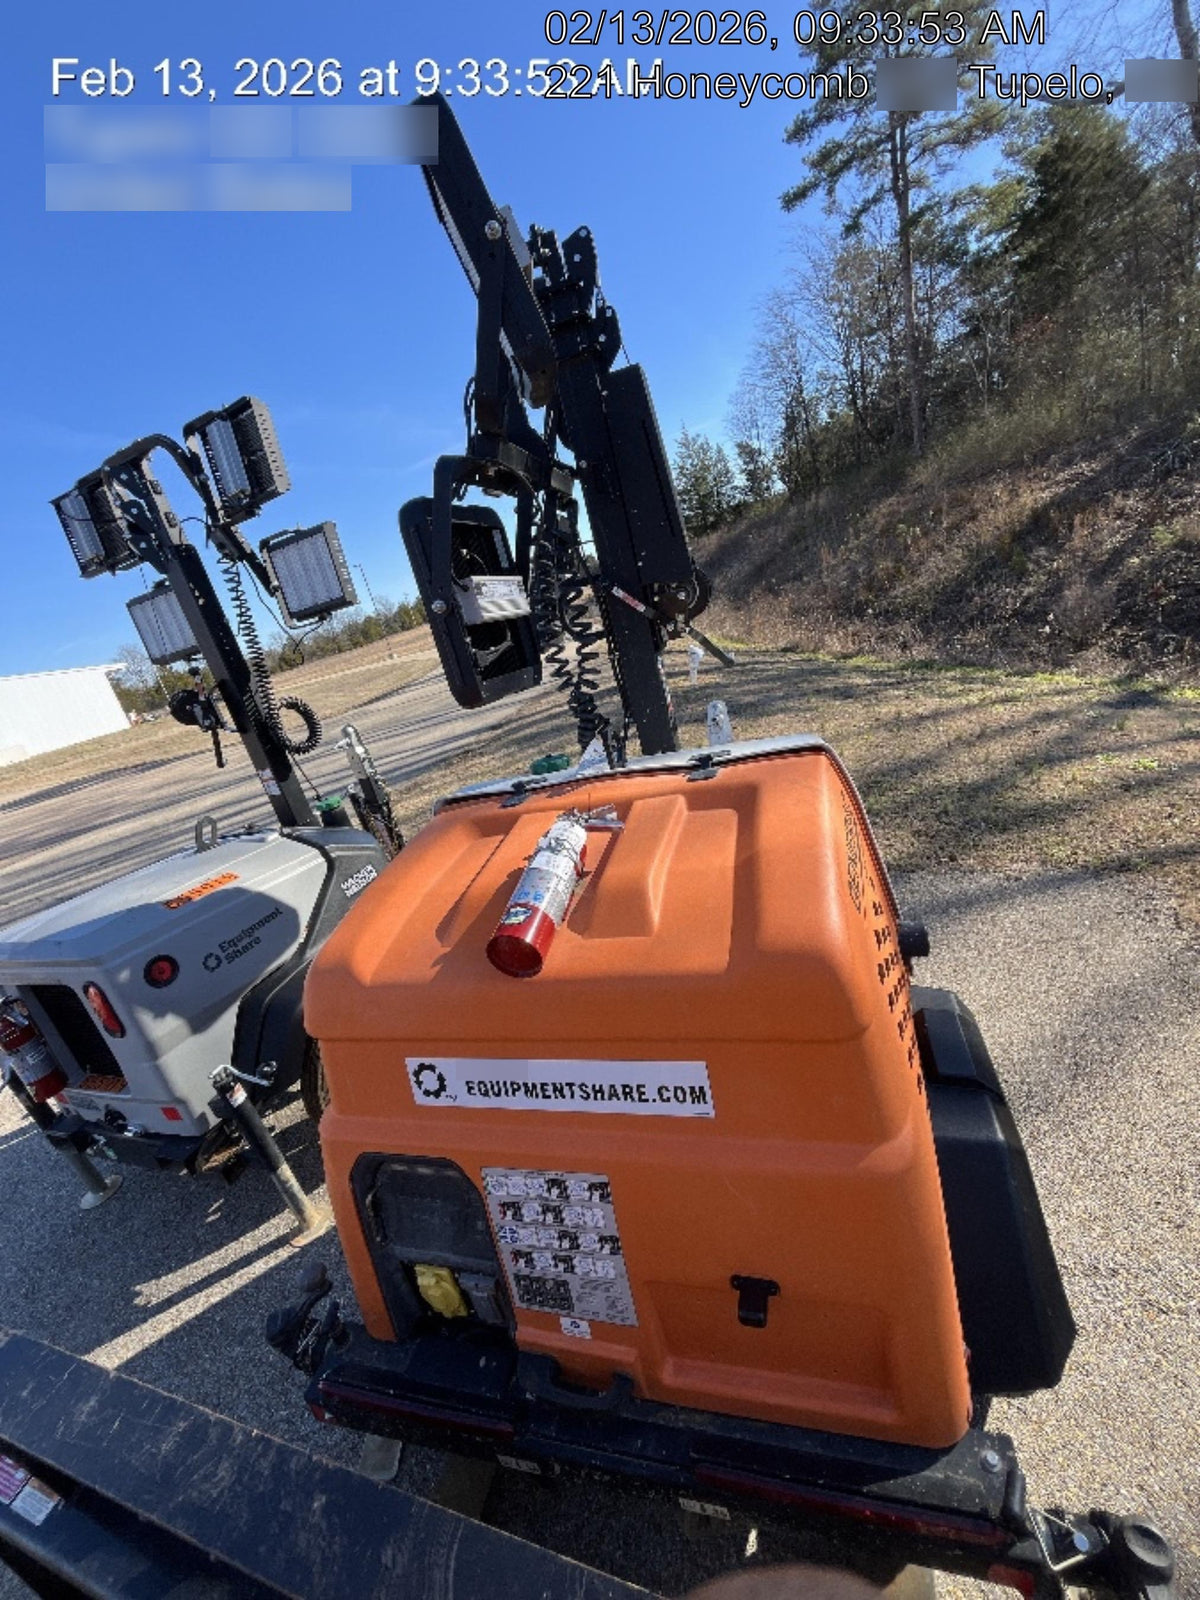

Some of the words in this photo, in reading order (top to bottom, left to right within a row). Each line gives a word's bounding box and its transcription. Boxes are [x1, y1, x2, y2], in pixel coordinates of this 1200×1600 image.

[218, 906, 283, 954] Equipment
[225, 936, 262, 965] Share
[465, 1079, 709, 1105] EQUIPMENTSHARE.COM
